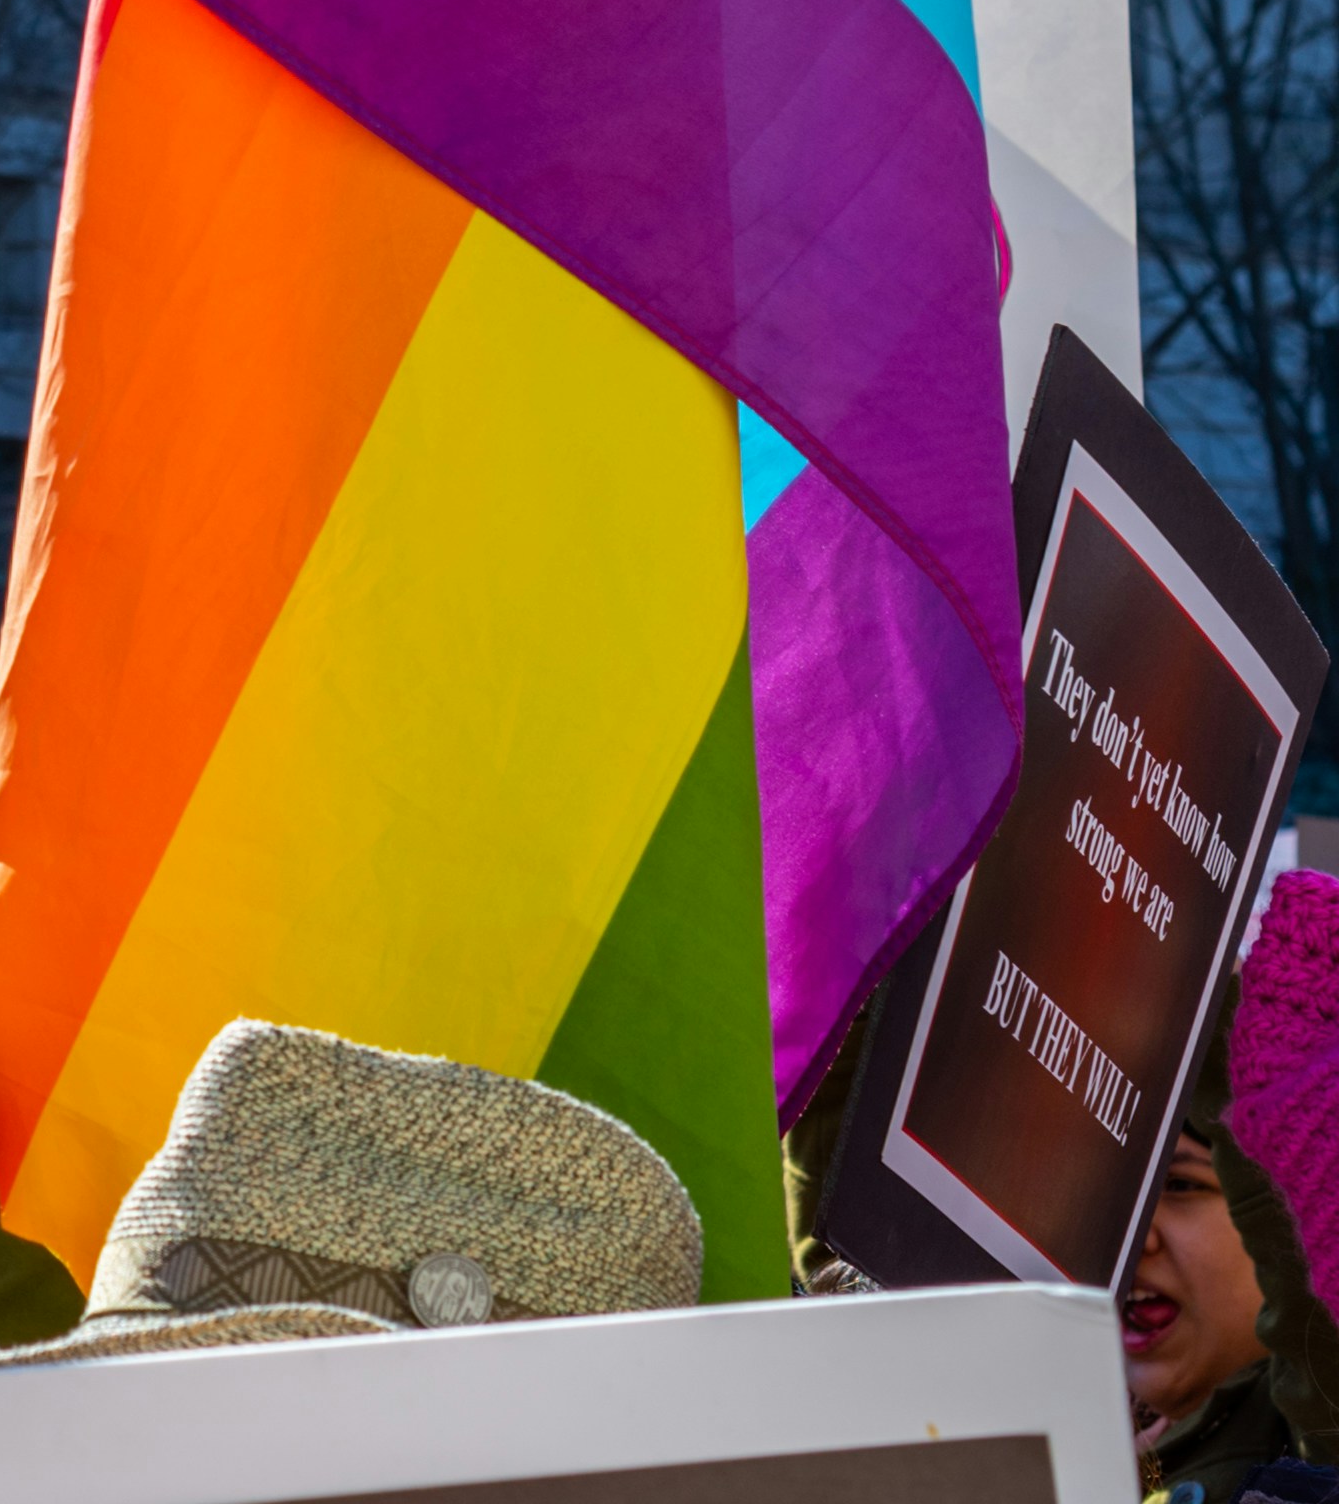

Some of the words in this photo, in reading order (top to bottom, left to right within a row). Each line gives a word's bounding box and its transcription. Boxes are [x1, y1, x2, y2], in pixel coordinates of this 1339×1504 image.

[1040, 627, 1096, 743] They
[1131, 749, 1172, 812] yet
[1162, 763, 1211, 859] know
[1203, 812, 1237, 893] how
[1065, 795, 1126, 903] strong
[1122, 854, 1149, 914] we
[1143, 884, 1175, 942] are
[982, 949, 1039, 1042] BUT
[1027, 992, 1093, 1094] THEY
[1081, 1045, 1141, 1147] WILL!
